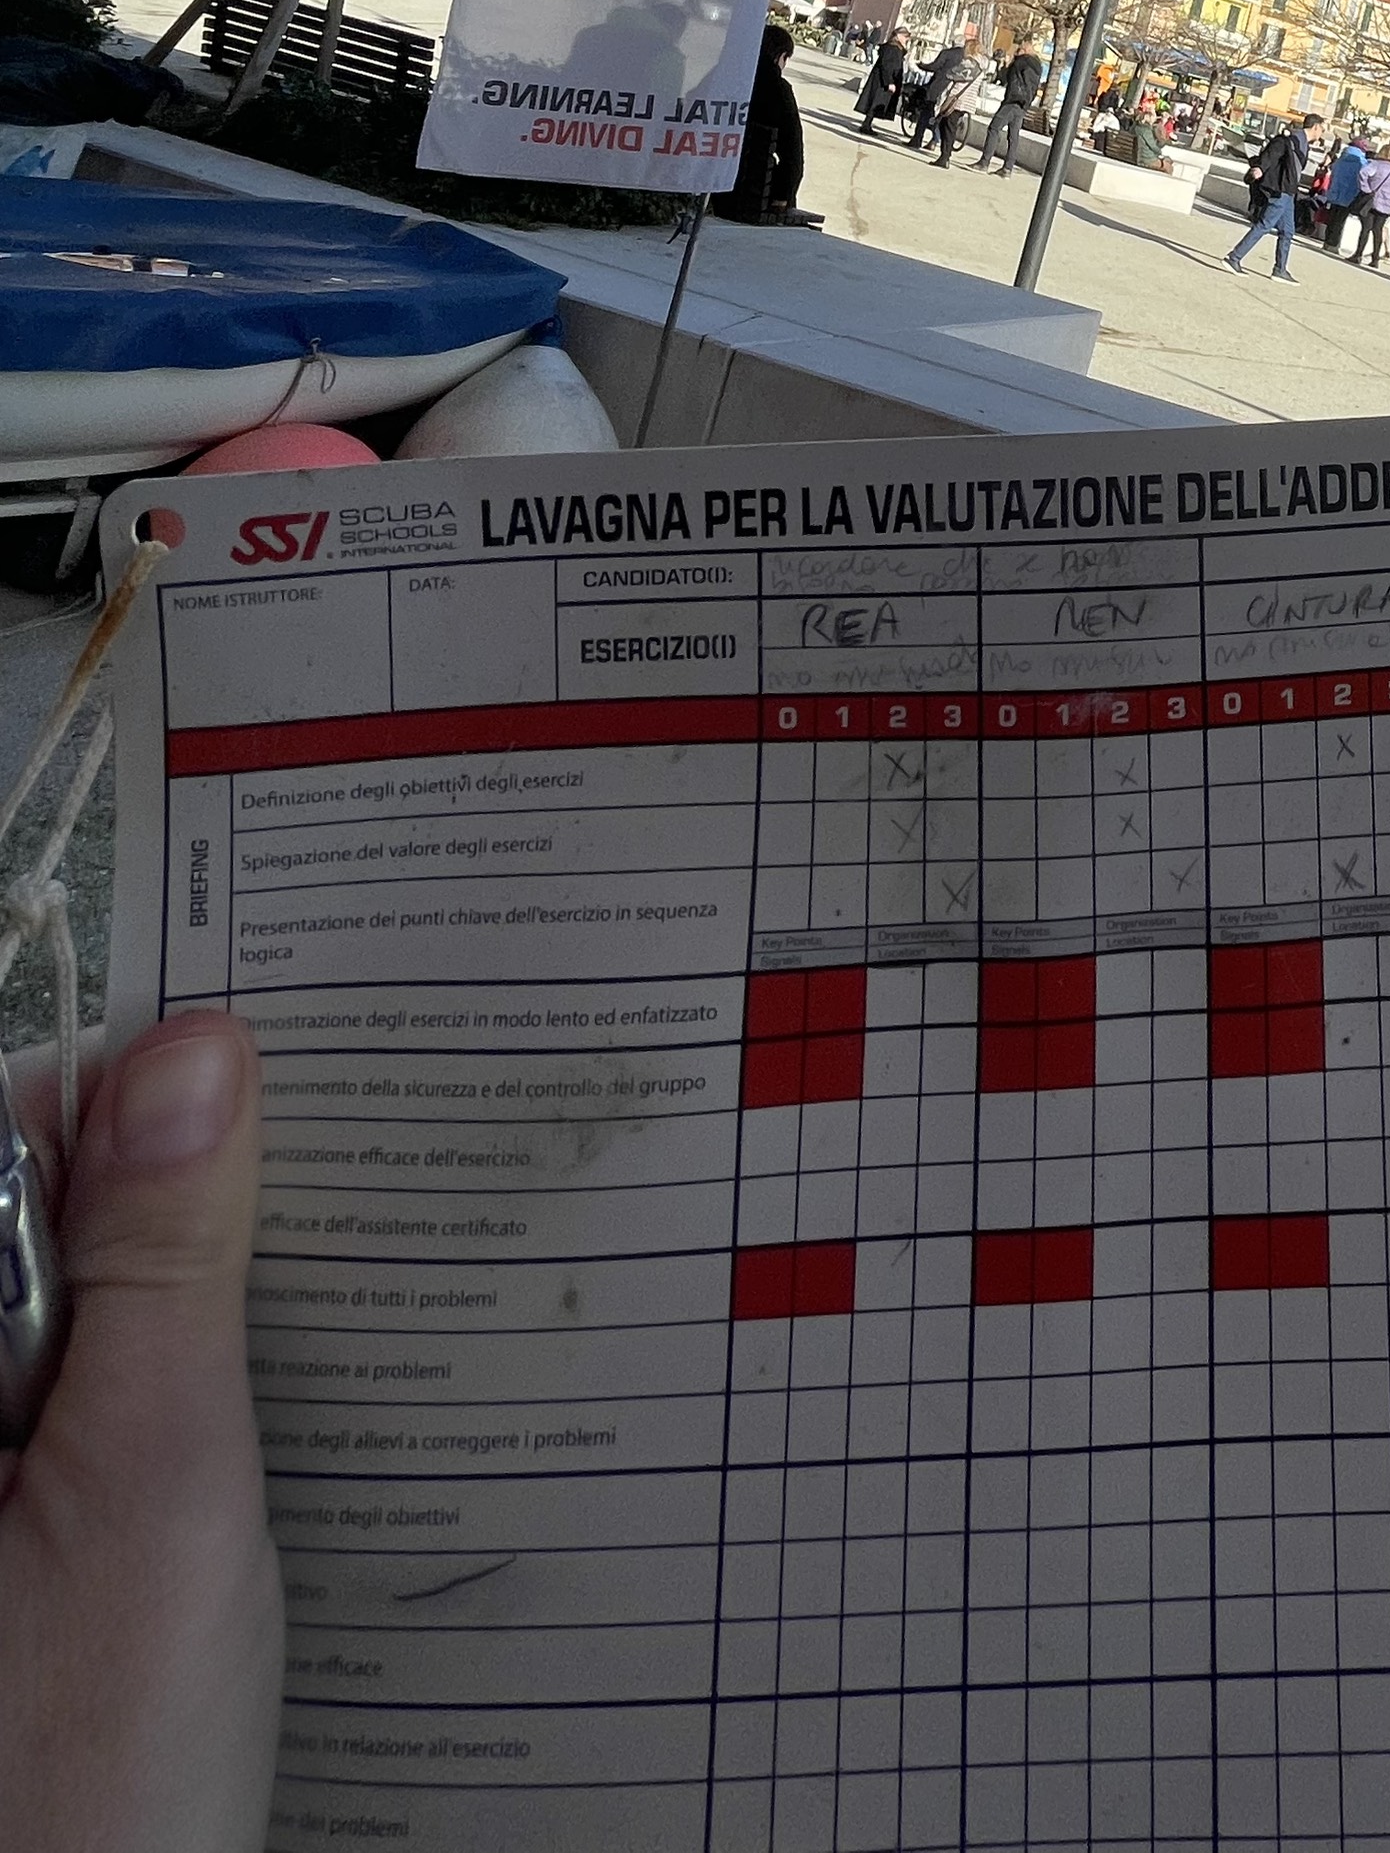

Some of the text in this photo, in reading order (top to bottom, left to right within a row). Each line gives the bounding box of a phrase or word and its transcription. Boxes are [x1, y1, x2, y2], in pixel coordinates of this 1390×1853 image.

[339, 501, 456, 526] SCUBA
[480, 492, 692, 547] LAVAGNA
[704, 487, 788, 539] PER
[801, 485, 854, 536] LA
[866, 473, 1164, 534] VALUTAZIONE
[229, 511, 330, 566] SSI
[339, 523, 458, 545] SCHOOLS
[340, 541, 457, 560] INTERNATIONAL
[408, 576, 456, 593] DATA:
[582, 565, 734, 590] CANDIDATO(I):
[173, 586, 322, 611] NOME ISTRUTTORE:
[801, 600, 900, 647] REA
[580, 635, 737, 665] ESERCIZIO(I)
[1224, 693, 1241, 715] 0
[1280, 688, 1294, 710] 1
[1334, 684, 1351, 706] 2
[779, 705, 961, 729] 0 1 2 3
[999, 697, 1186, 728] 0 1 2 3
[241, 770, 584, 811] Definizione degli obiettivi degli esercizi
[240, 836, 553, 873] Spiegazione del valore degli esercizi
[190, 838, 209, 927] BRIEFING
[239, 902, 718, 938] Presentazione dei punti chiave dell'esercizio in sequenza
[239, 943, 293, 965] logica
[366, 1009, 407, 1032] degli
[410, 1009, 469, 1028] esercizi
[473, 1009, 488, 1028] in
[492, 1010, 542, 1028] modo
[545, 1008, 590, 1027] lento
[594, 1007, 616, 1026] ed
[620, 1005, 717, 1025] enfatizzato
[262, 1075, 706, 1098] ntenimento della sicurezza e del controllo del gruppo
[262, 1147, 531, 1167] anizzazione efficace dell'esercizio
[260, 1214, 528, 1237] efficace dell'assistente certificato
[351, 1290, 366, 1308] di
[369, 1290, 405, 1308] tutti
[419, 1290, 497, 1310] problemi
[354, 1361, 369, 1379] ai
[372, 1360, 451, 1382] problemi
[308, 1429, 350, 1453] degli
[354, 1430, 404, 1451] allievi
[408, 1435, 418, 1450] a
[421, 1432, 519, 1454] correggere
[534, 1426, 616, 1449] problemi
[338, 1506, 383, 1530] degli
[386, 1506, 460, 1527] obiettivi
